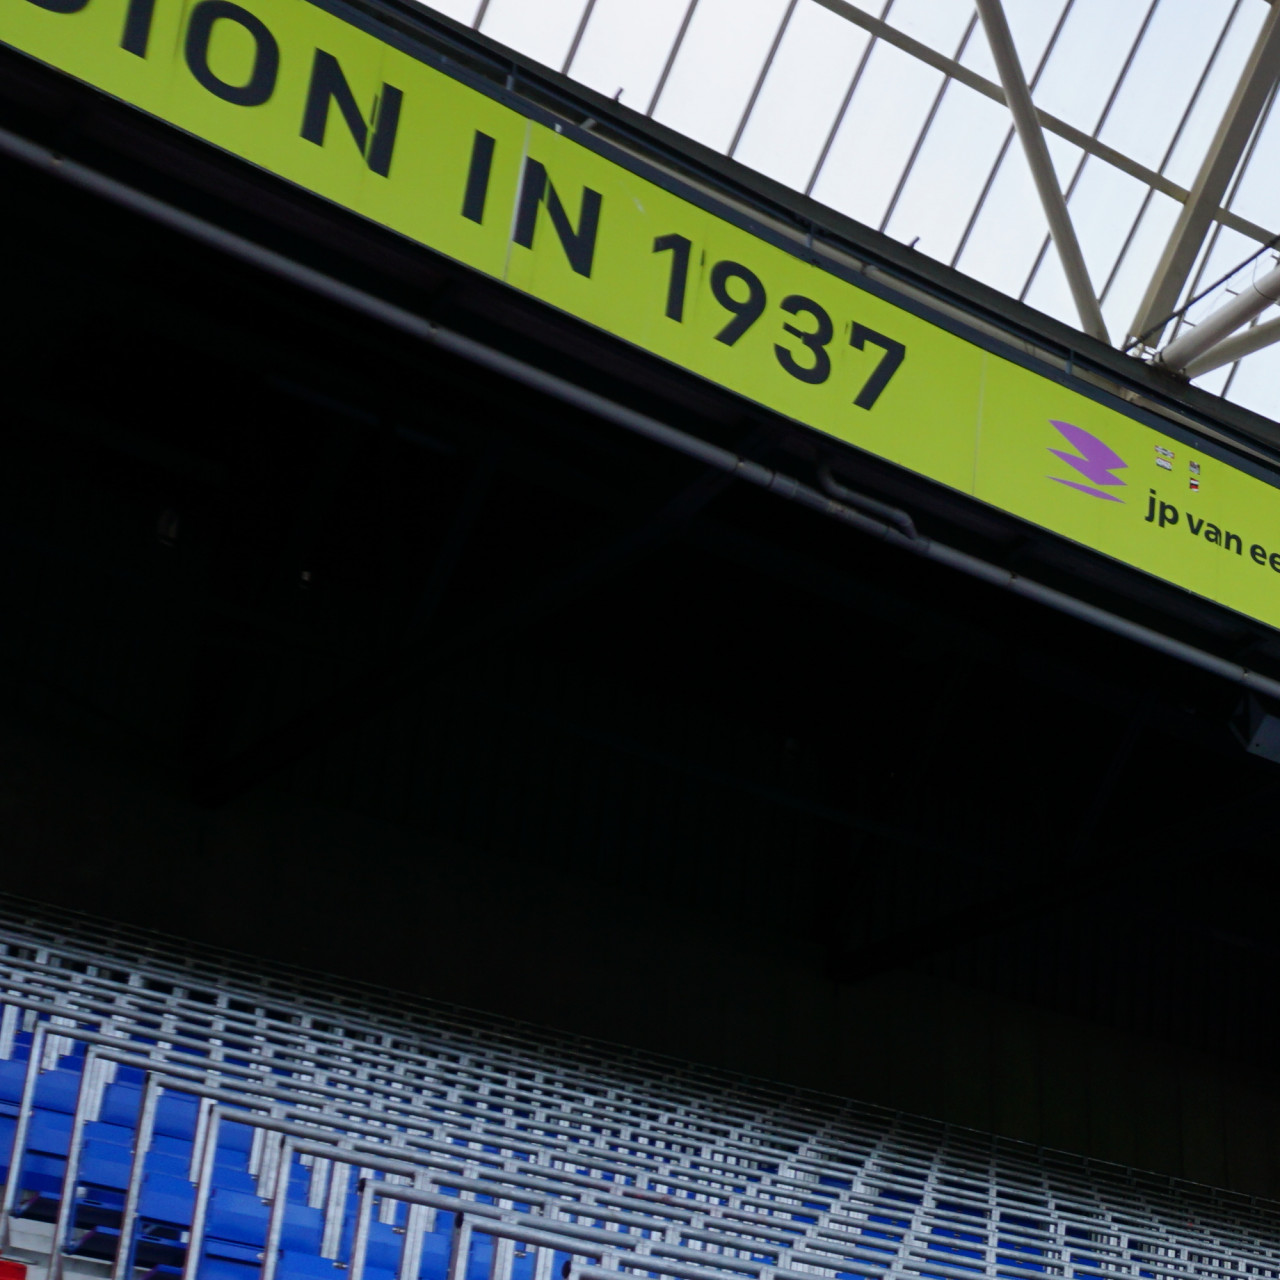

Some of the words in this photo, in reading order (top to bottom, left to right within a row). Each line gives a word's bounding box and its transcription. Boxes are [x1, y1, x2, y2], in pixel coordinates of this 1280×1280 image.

[25, 0, 404, 179] ION
[461, 129, 603, 279] IN
[652, 233, 906, 411] 1937
[1144, 488, 1180, 528] jp
[1186, 512, 1243, 556] van
